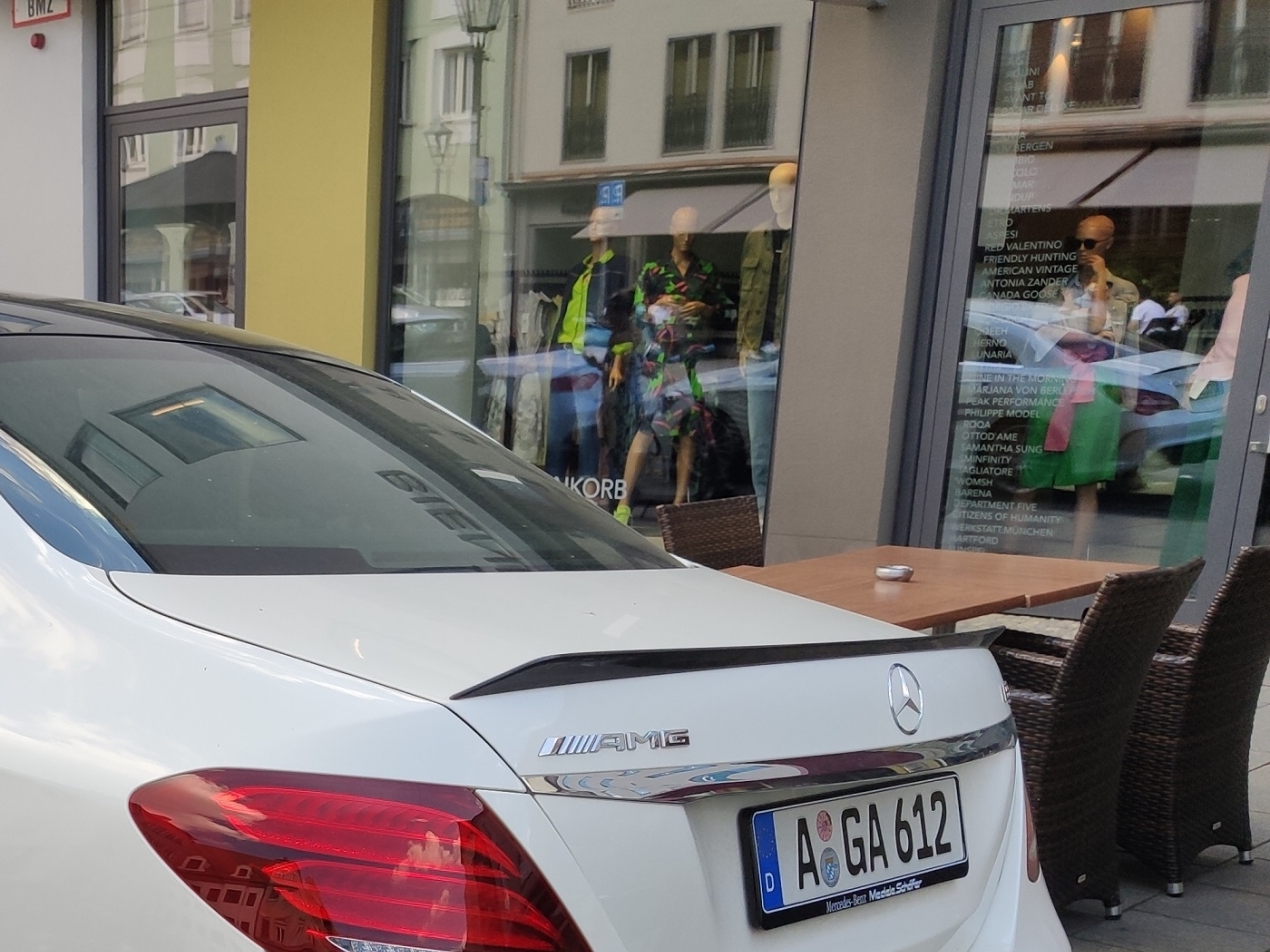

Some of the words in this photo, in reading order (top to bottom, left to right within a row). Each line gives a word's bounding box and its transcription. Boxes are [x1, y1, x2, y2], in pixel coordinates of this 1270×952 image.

[28, 0, 54, 18] BMZ
[985, 243, 1003, 252] RED
[1006, 240, 1063, 251] VALENTINO
[983, 254, 1028, 264] FRIENDLY
[1030, 252, 1077, 262] HUNTING
[982, 266, 1033, 276] AMERICAN
[1035, 264, 1079, 274] VINTAGE
[981, 279, 1027, 288] ANTONIA
[1027, 277, 1069, 287] ZANDER
[979, 290, 1021, 300] CANADA
[1023, 289, 1059, 299] GOOSE
[994, 373, 1005, 383] IN
[1006, 374, 1026, 383] THE
[1015, 386, 1038, 395] VON
[965, 397, 990, 406] PEAK
[992, 397, 1065, 407] PERFORMANCE
[964, 408, 1004, 418] PHILIPPE
[1006, 409, 1041, 419] MODEL
[961, 443, 1013, 453] SAMANTHA
[1015, 444, 1043, 454] SUNG
[956, 477, 994, 487] WOMSH
[955, 488, 992, 498] BARENA
[953, 499, 1016, 510] DEPARTMENT
[1017, 502, 1038, 512] FIVE
[952, 510, 993, 520] CITIZENS
[994, 512, 1008, 521] OF
[1011, 513, 1064, 524] HUMANITY
[600, 728, 691, 752] AMG
[797, 817, 820, 890] A
[841, 803, 889, 876] GA
[895, 790, 952, 864] 612
[765, 872, 775, 893] D
[826, 893, 868, 914] Mercedes-Benz
